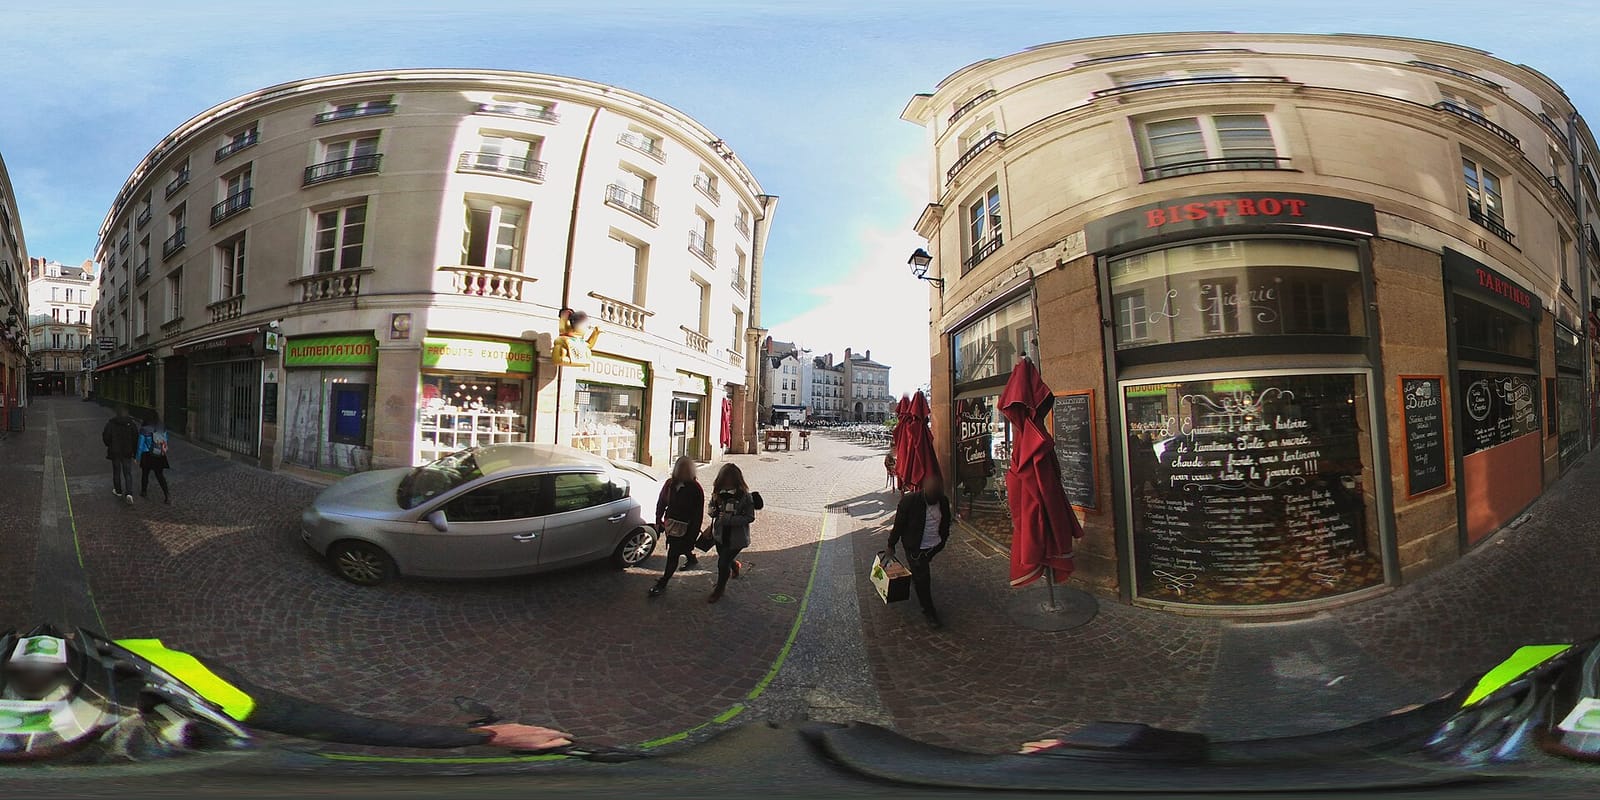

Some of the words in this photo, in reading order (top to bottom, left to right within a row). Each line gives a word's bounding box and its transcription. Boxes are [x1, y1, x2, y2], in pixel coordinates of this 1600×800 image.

[1144, 198, 1308, 228] BISTROT
[1475, 268, 1531, 309] TARTINES
[290, 343, 372, 358] ALIMENTATION
[427, 346, 473, 357] PRODUITS
[481, 349, 532, 362] EXOTIQUES
[1275, 415, 1308, 430] histoire
[1177, 442, 1188, 453] de
[1171, 455, 1204, 468] chaude
[1259, 456, 1279, 464] nous
[1282, 450, 1321, 462] tartinons
[1170, 474, 1189, 487] pour
[1219, 470, 1245, 481] toute
[1250, 466, 1260, 479] la
[1263, 465, 1302, 486] journée
